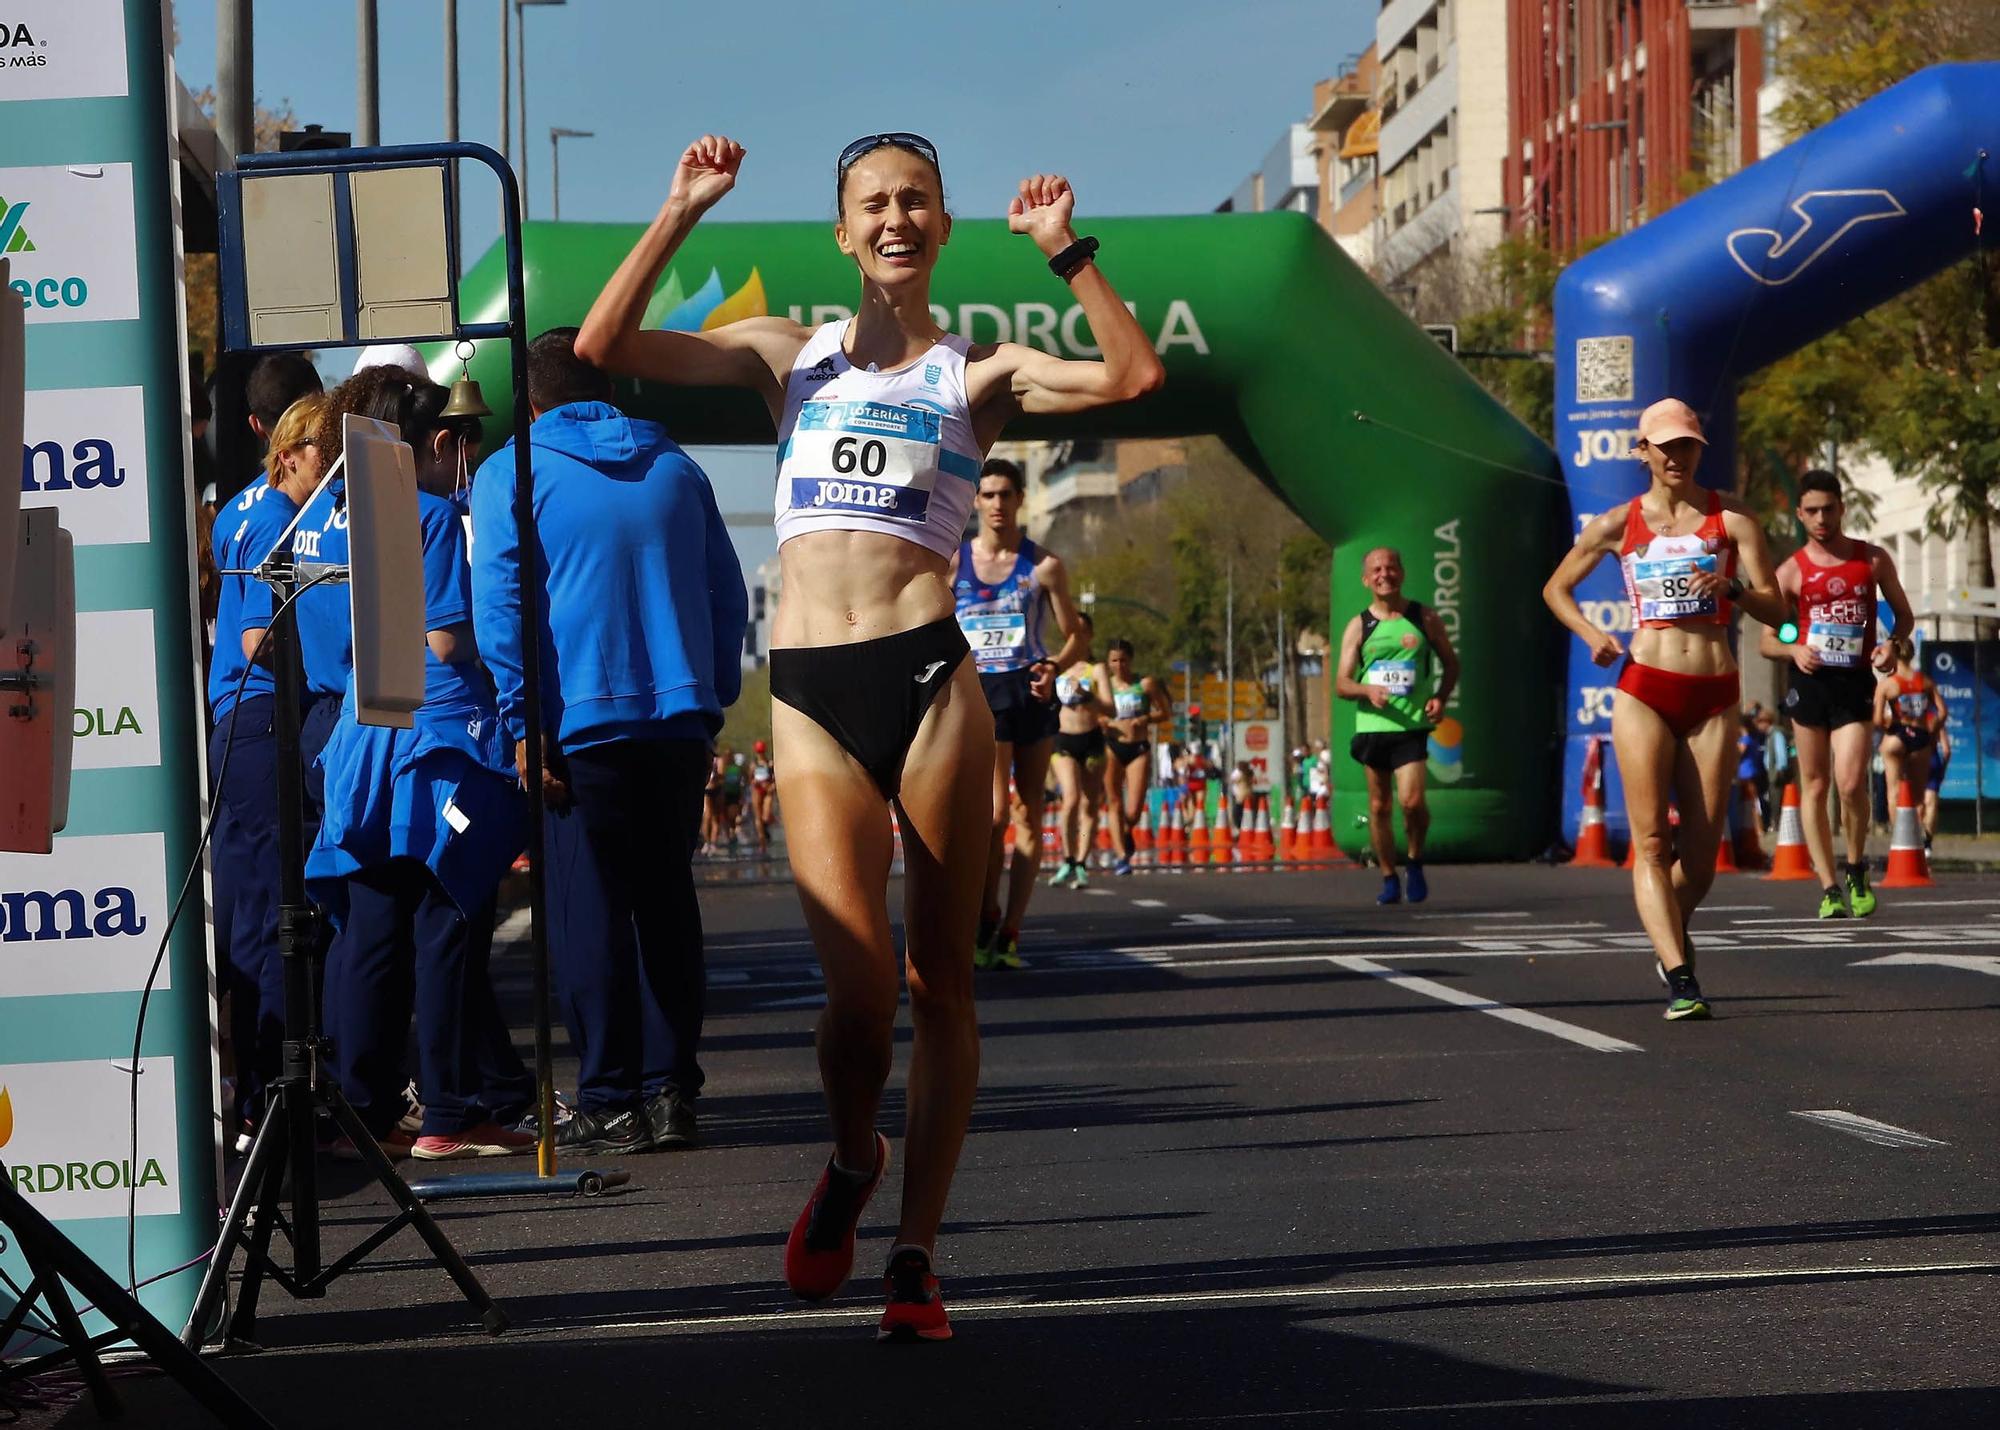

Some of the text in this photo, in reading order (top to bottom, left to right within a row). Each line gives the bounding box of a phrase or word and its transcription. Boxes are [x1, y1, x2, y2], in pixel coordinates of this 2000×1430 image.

[10, 50, 47, 67] más
[850, 406, 909, 423] LOTERÍAS
[831, 436, 887, 477] 60
[814, 480, 898, 509] Joma
[1662, 577, 1690, 598] 89
[1809, 602, 1868, 620] ELCHE
[983, 631, 1004, 647] 27
[1824, 637, 1845, 651] 42
[1382, 671, 1400, 685] 49
[72, 707, 143, 737] OLA
[0, 886, 147, 942] ma
[11, 1158, 168, 1194] RDROLA
